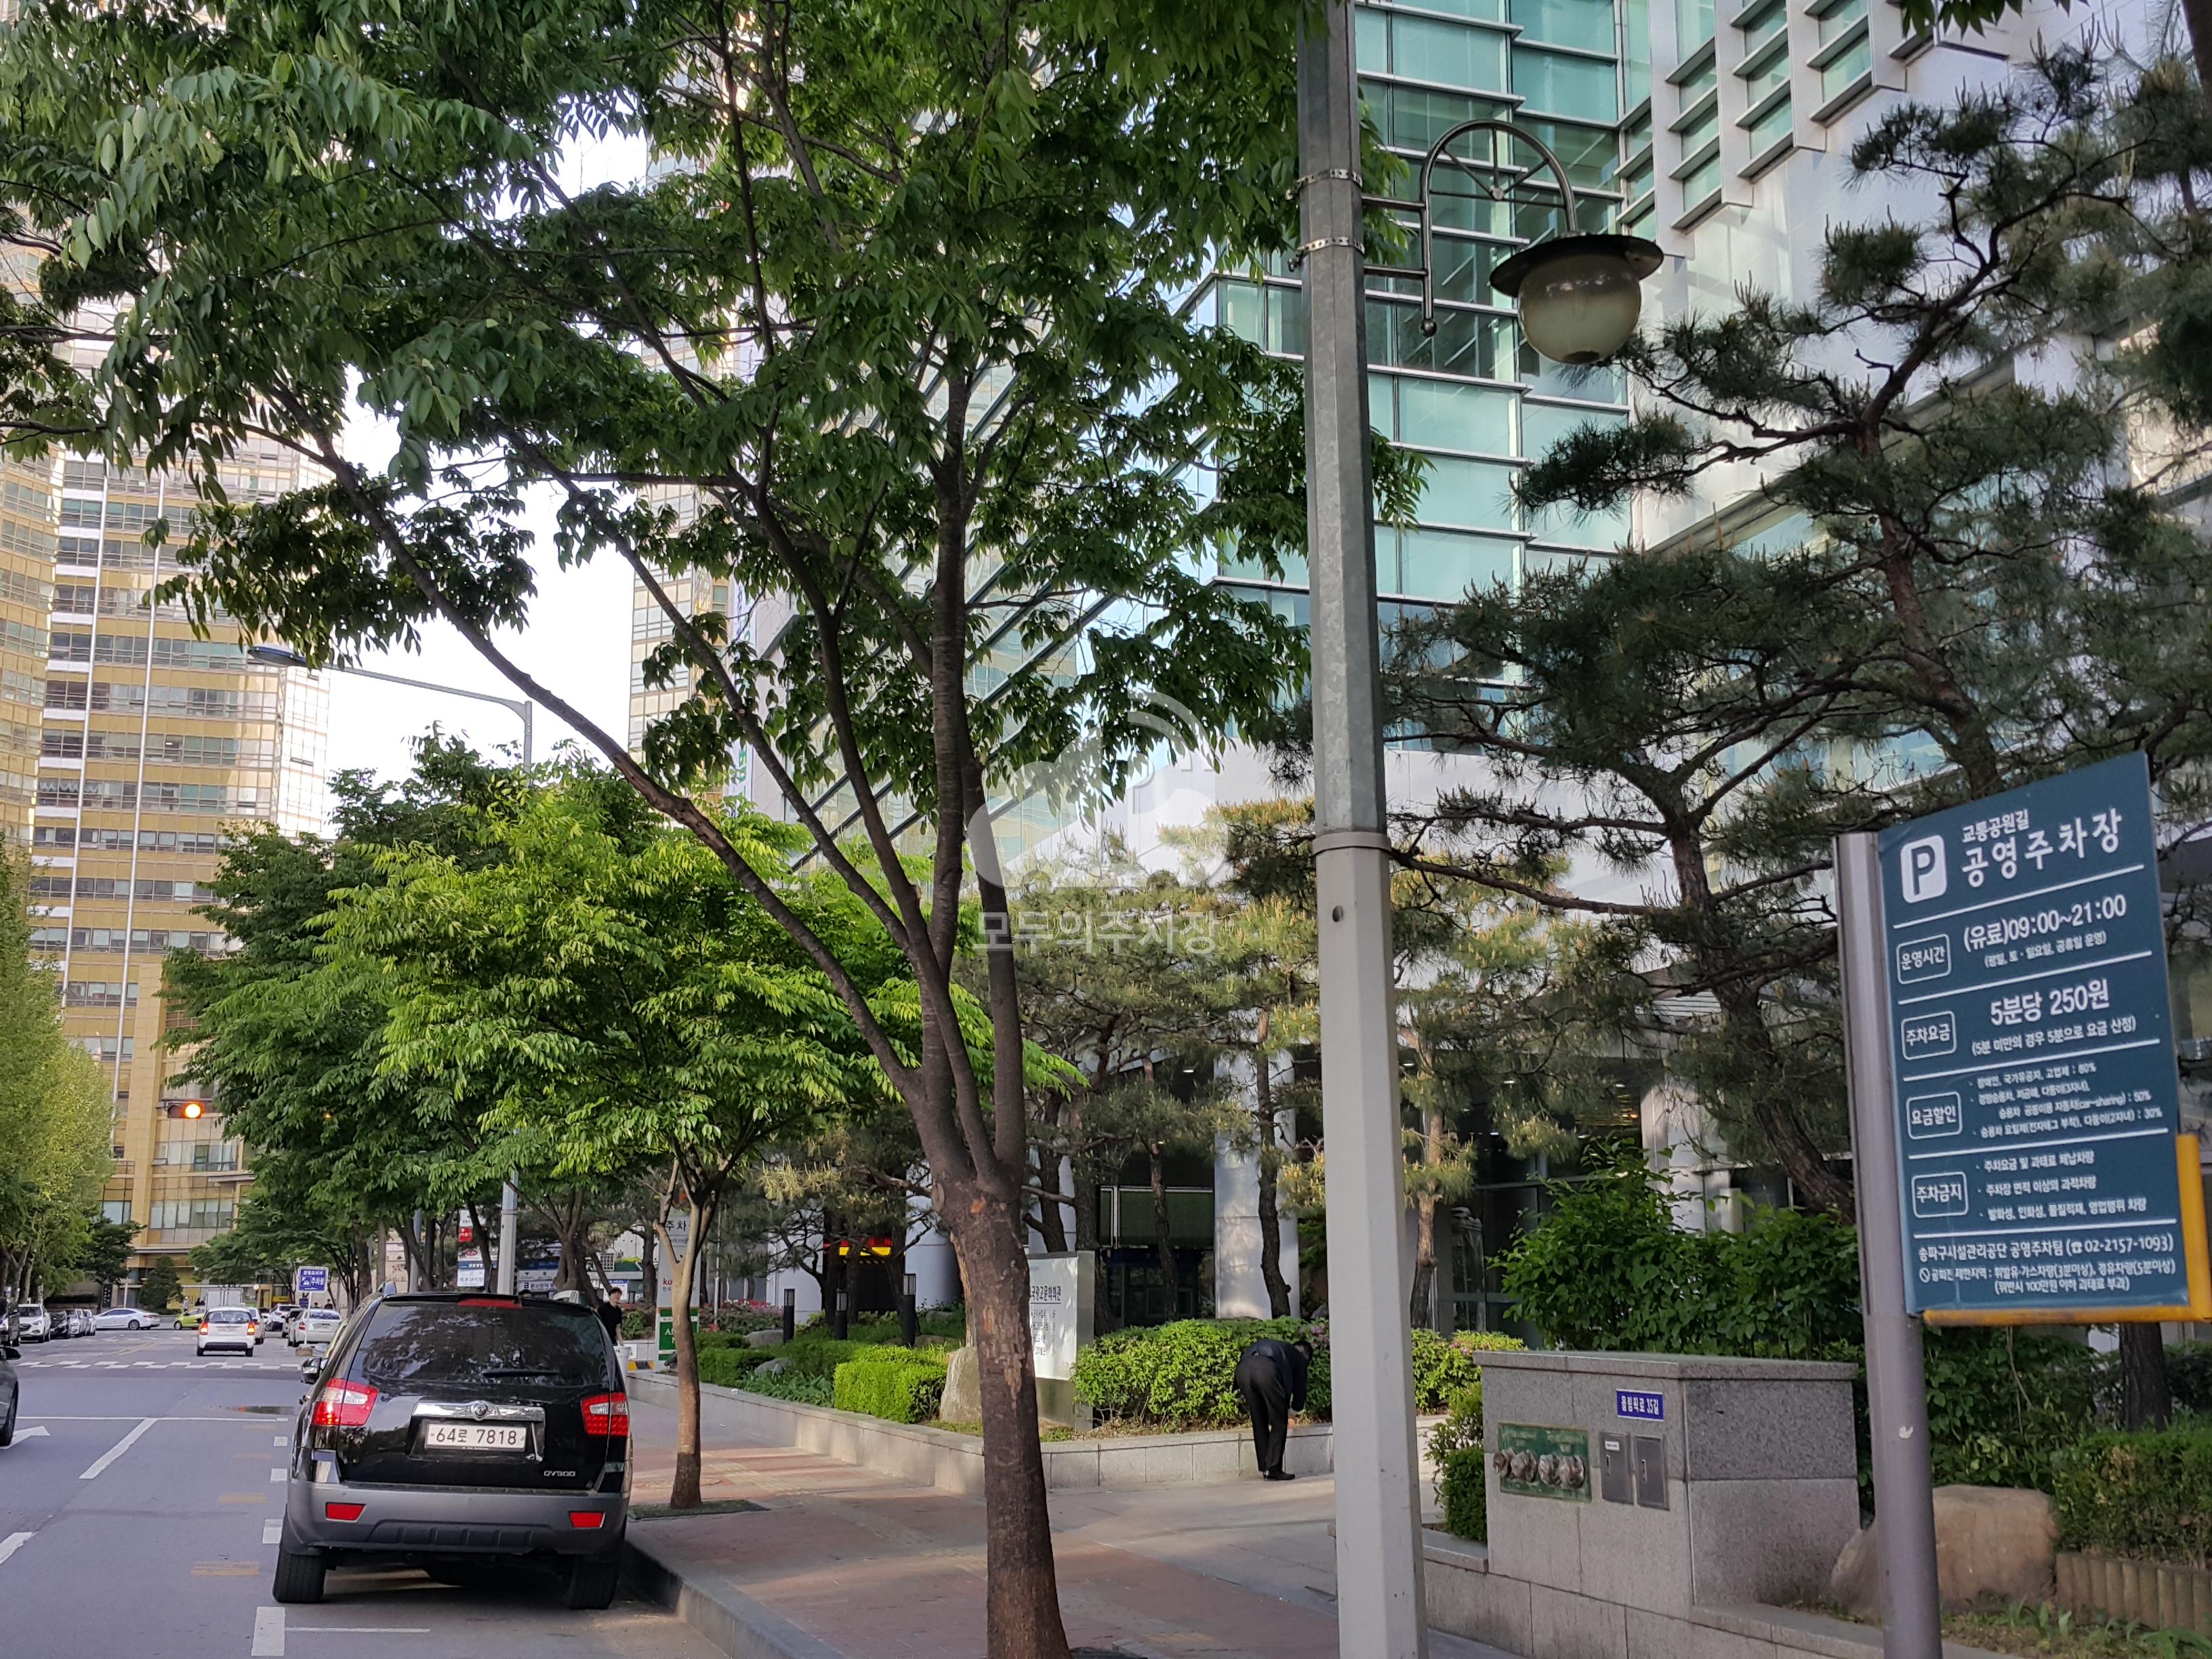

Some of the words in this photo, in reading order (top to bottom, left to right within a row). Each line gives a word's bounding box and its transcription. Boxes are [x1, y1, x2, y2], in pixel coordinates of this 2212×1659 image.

[1962, 808, 2029, 843] 교통공원길
[1962, 806, 2123, 887] 공영주차장
[1910, 844, 1936, 895] P
[1901, 946, 1946, 970] 운영시간
[1990, 991, 2043, 1026] 5분당
[2049, 978, 2110, 1015] 250원
[1906, 1023, 1951, 1047] 주차요금
[1993, 1034, 2023, 1052] 미만의
[2025, 1031, 2045, 1048] 경우
[2047, 1025, 2084, 1044] 5분으로
[2087, 1021, 2108, 1037] 요금
[1911, 1105, 1957, 1126] 요금할인
[1984, 1158, 2018, 1172] 주차요금
[2019, 1156, 2028, 1170] 및
[2031, 1154, 2057, 1168] 과태료
[1917, 1183, 1962, 1204] 주차금지
[1986, 1182, 2011, 1196] 주차장
[2013, 1181, 2031, 1195] 면적
[2032, 1179, 2060, 1193] 이상의
[1918, 1243, 2007, 1262] 송파구시설관리공단
[2010, 1239, 2064, 1258] 공영주차팀
[1030, 1286, 1061, 1300] 국광고문화회관
[436, 1428, 467, 1443] 64로
[476, 1429, 517, 1446] 7818
